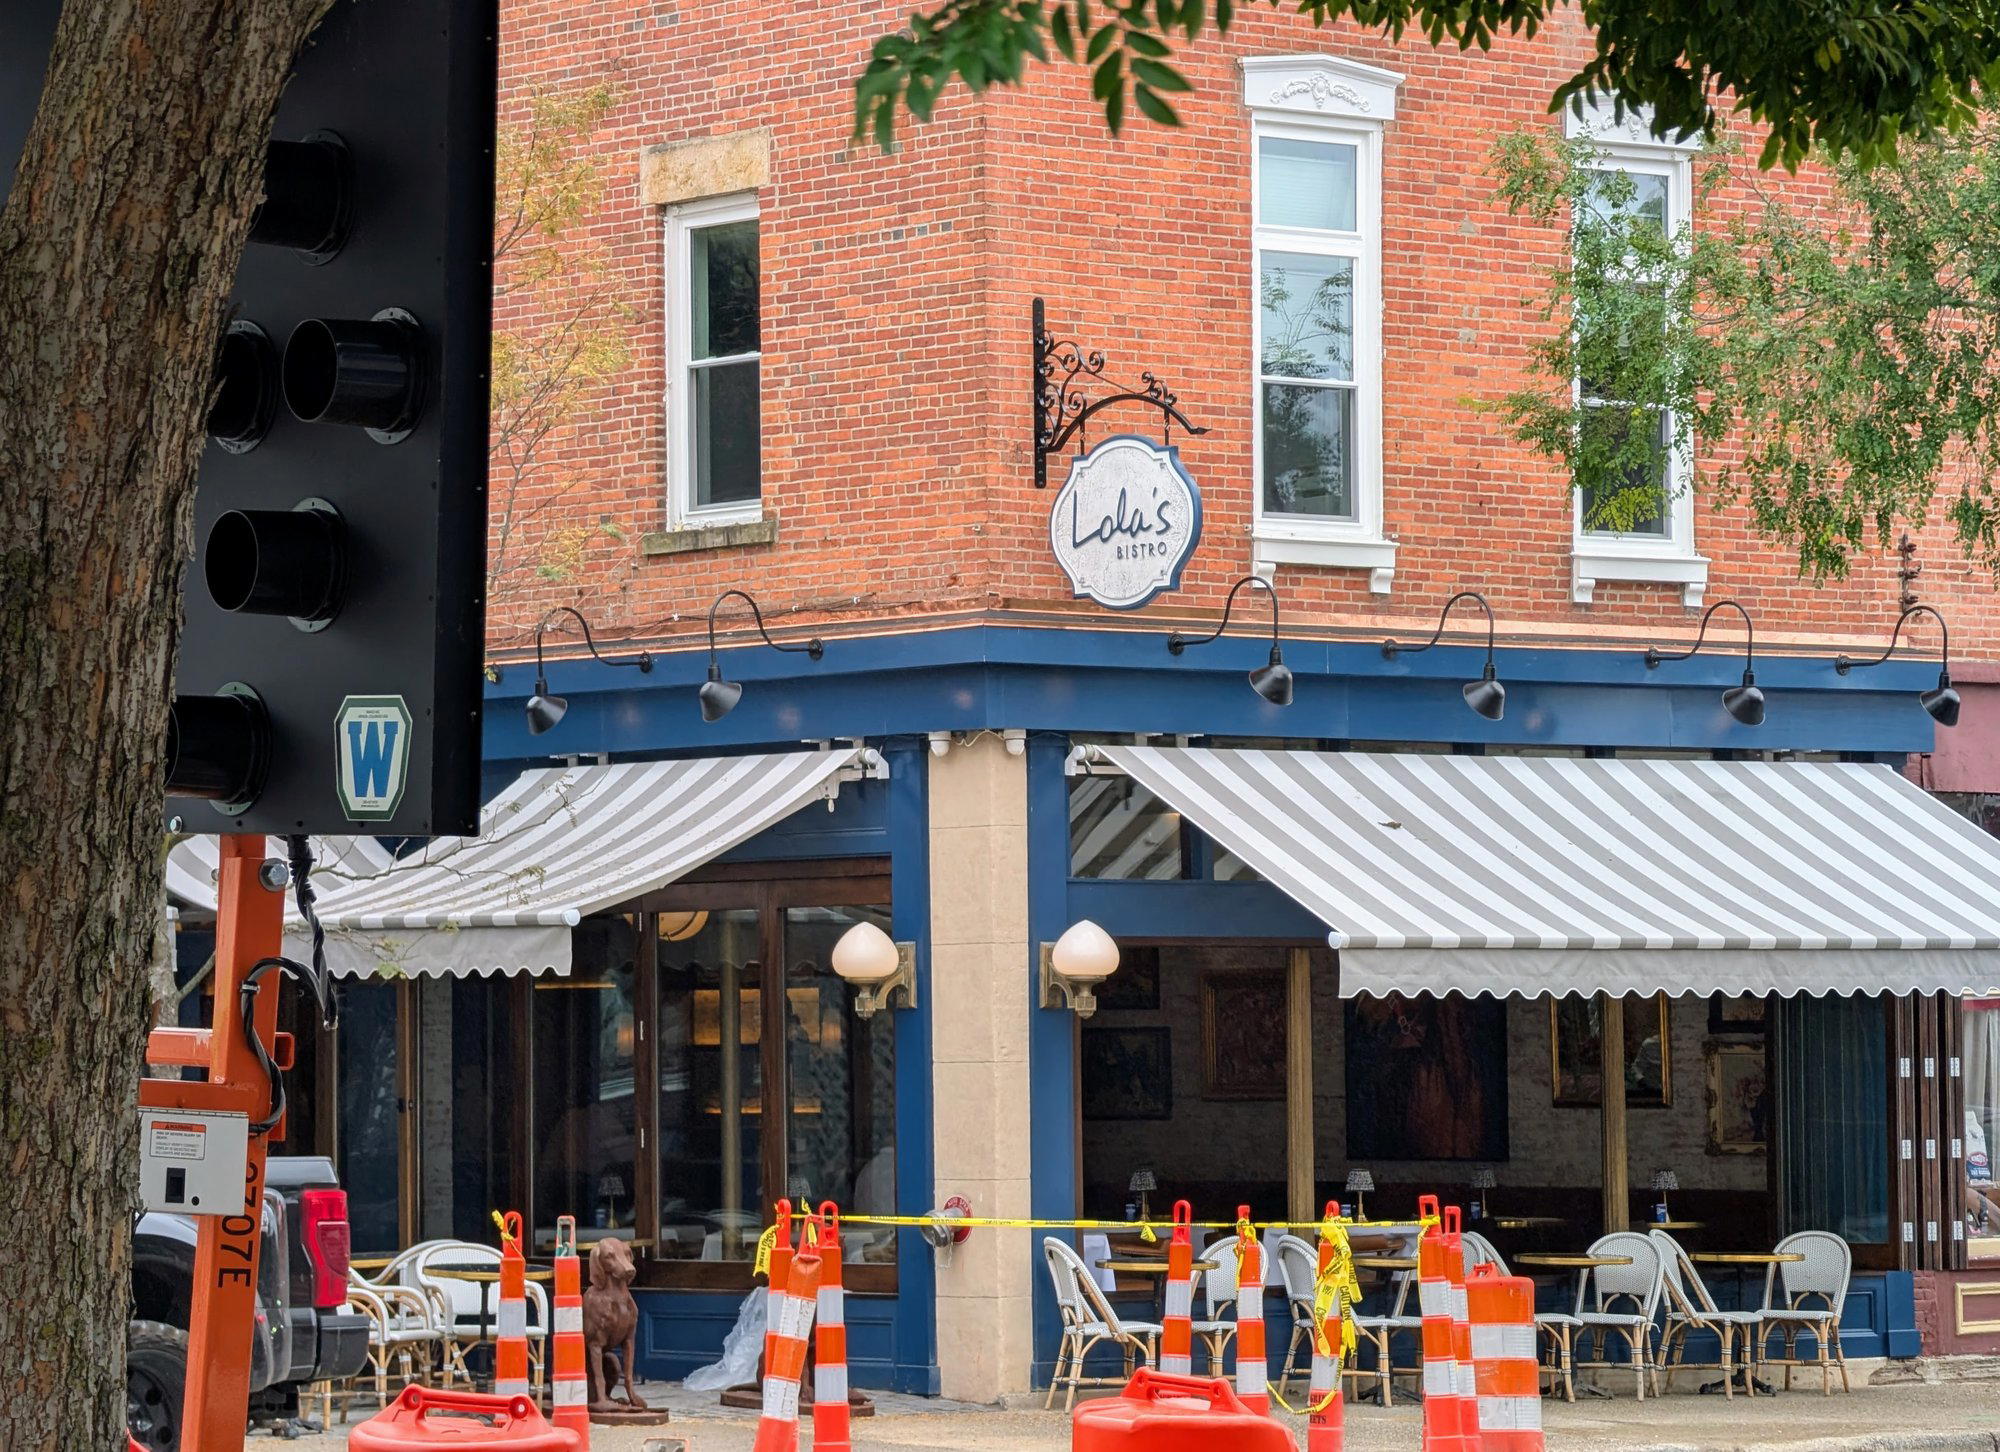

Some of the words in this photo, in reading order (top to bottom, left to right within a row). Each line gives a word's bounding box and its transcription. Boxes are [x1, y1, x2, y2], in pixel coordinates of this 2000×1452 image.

[1072, 486, 1171, 549] Lola's
[1116, 541, 1167, 560] BISTRO
[347, 720, 399, 798] W
[1340, 1285, 1352, 1321] CAUTION
